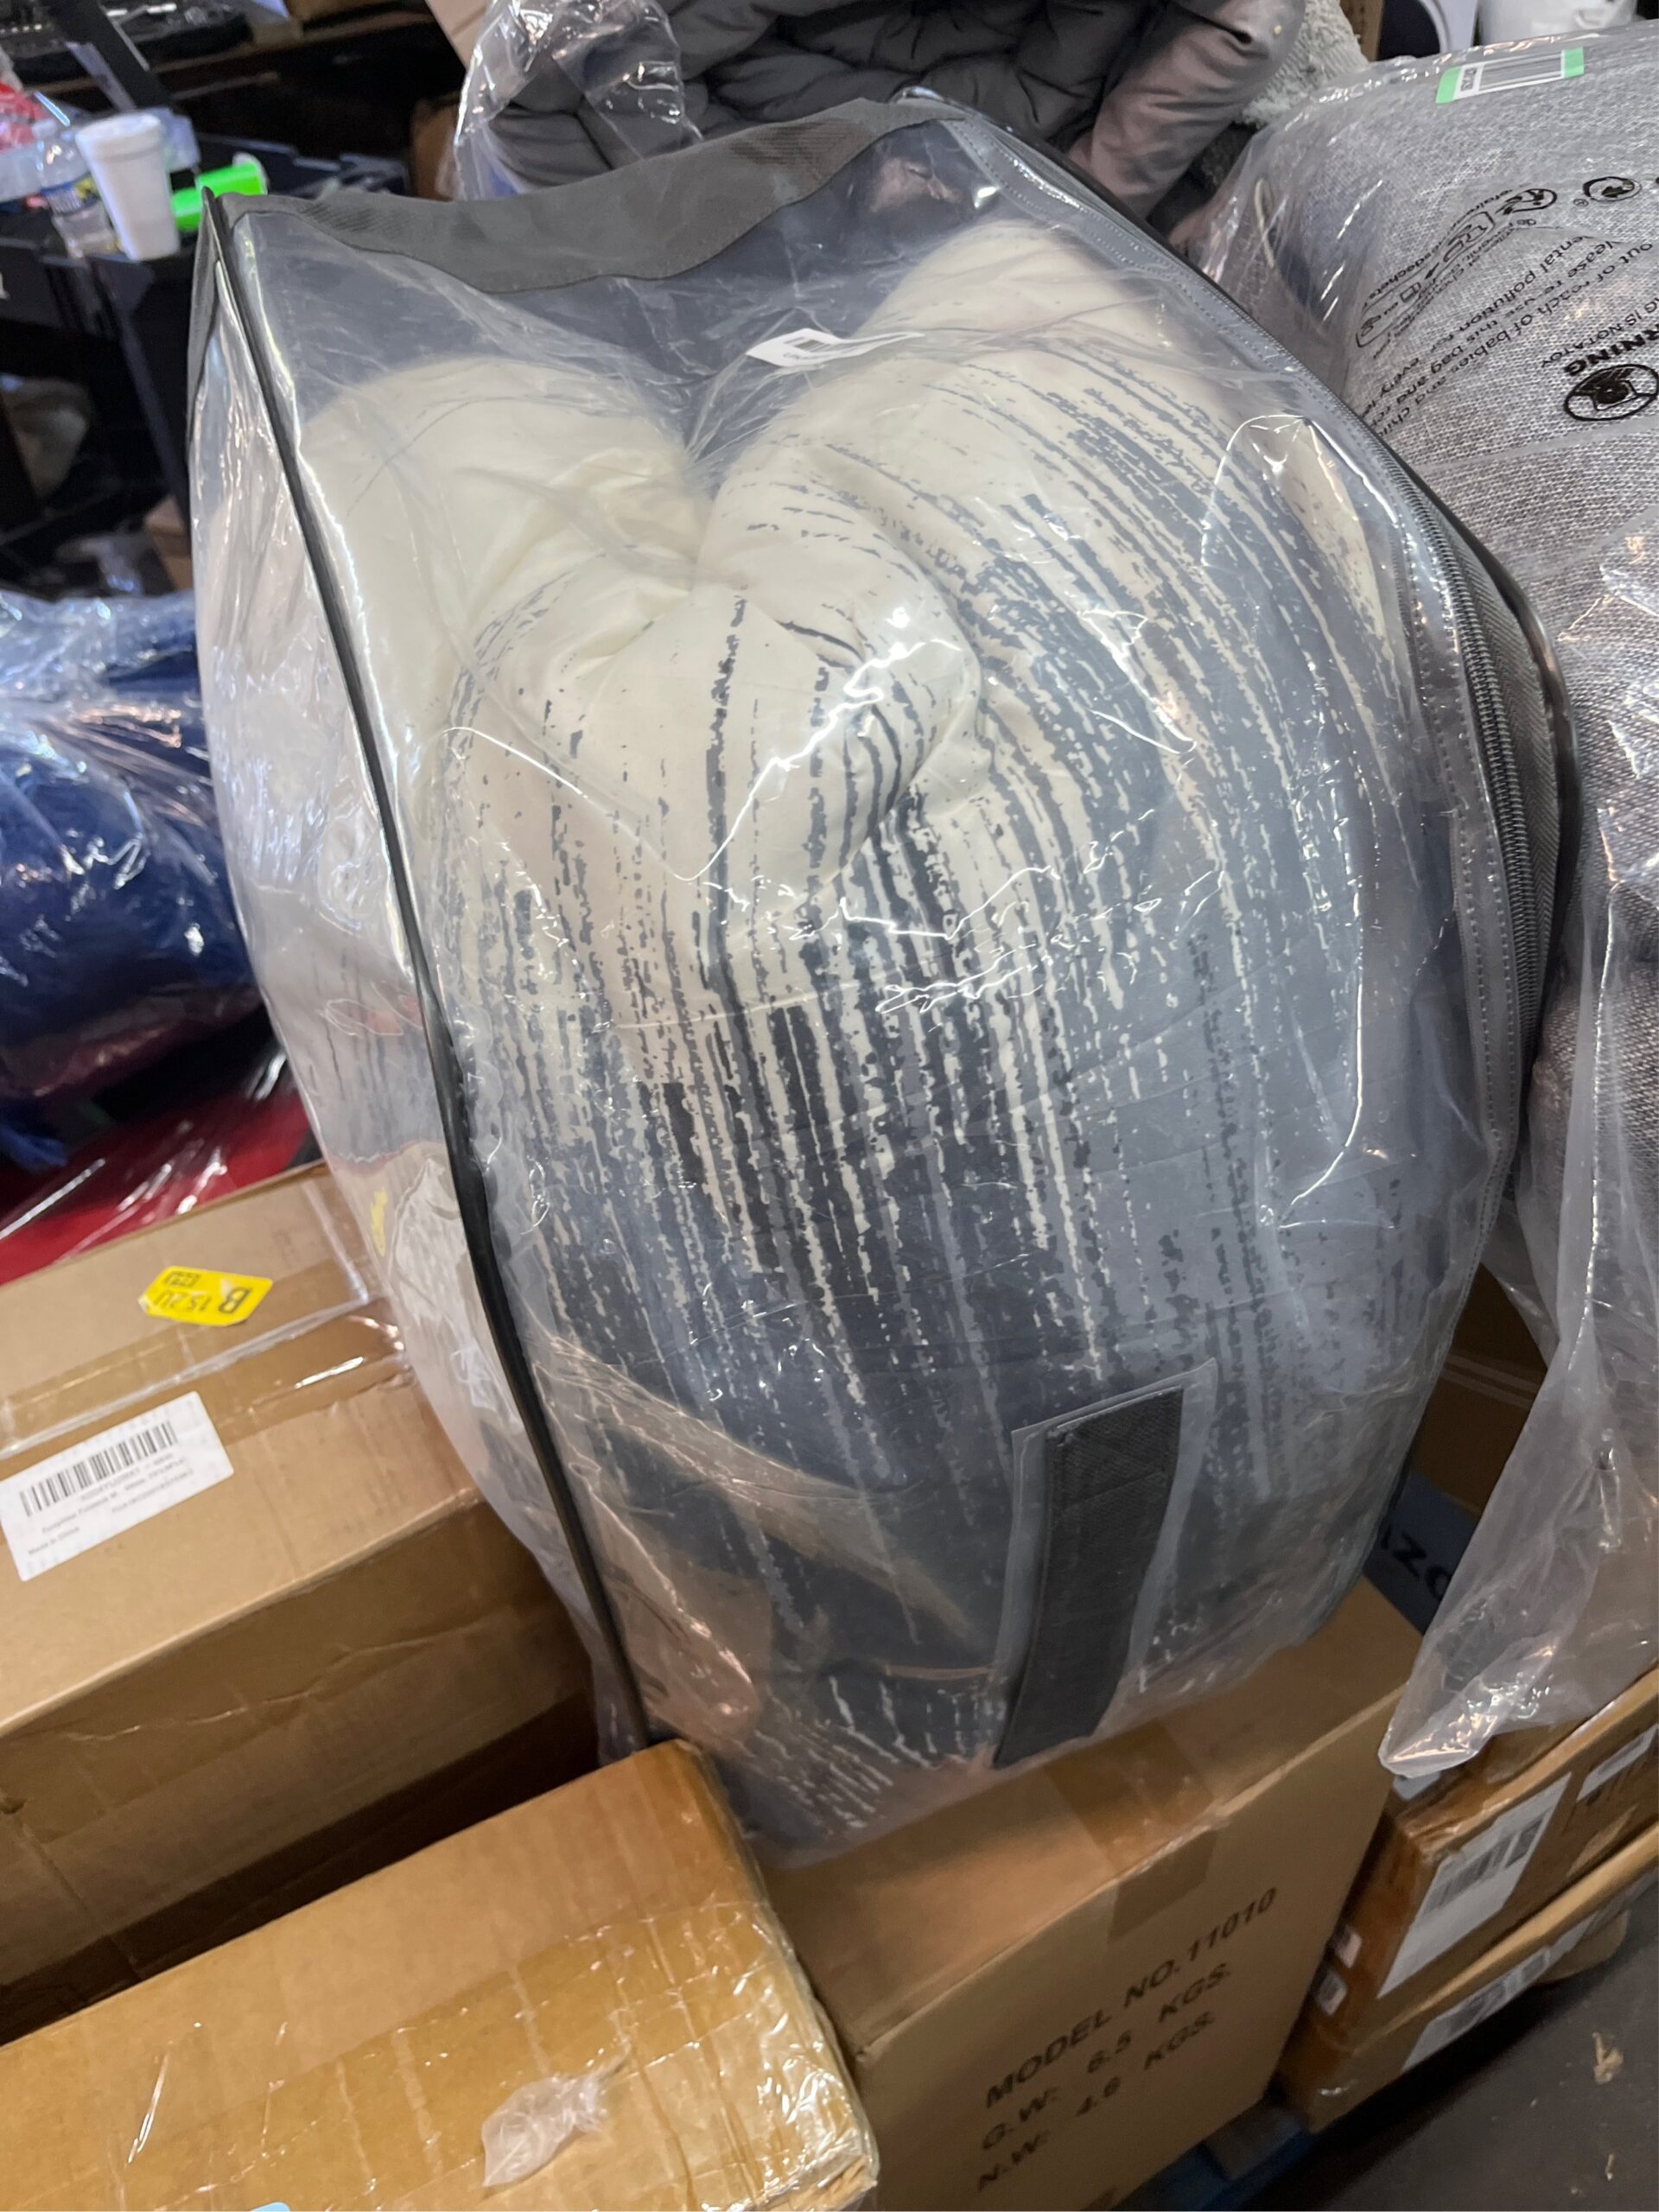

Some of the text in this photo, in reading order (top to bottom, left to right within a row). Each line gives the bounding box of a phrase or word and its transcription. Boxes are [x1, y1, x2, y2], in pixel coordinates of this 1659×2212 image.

[1567, 242, 1613, 277] lease
[1620, 243, 1652, 264] out
[1598, 265, 1615, 282] of
[1459, 271, 1535, 331] pollution
[1538, 281, 1590, 315] reach
[1514, 315, 1532, 335] of
[1625, 310, 1641, 326] IS
[1466, 321, 1497, 343] this
[1431, 346, 1463, 373] bag
[1451, 331, 1510, 372] babies
[1396, 377, 1426, 404] and
[1415, 377, 1445, 404] and
[218, 1287, 253, 1314] B
[986, 2010, 1112, 2108] MODEL
